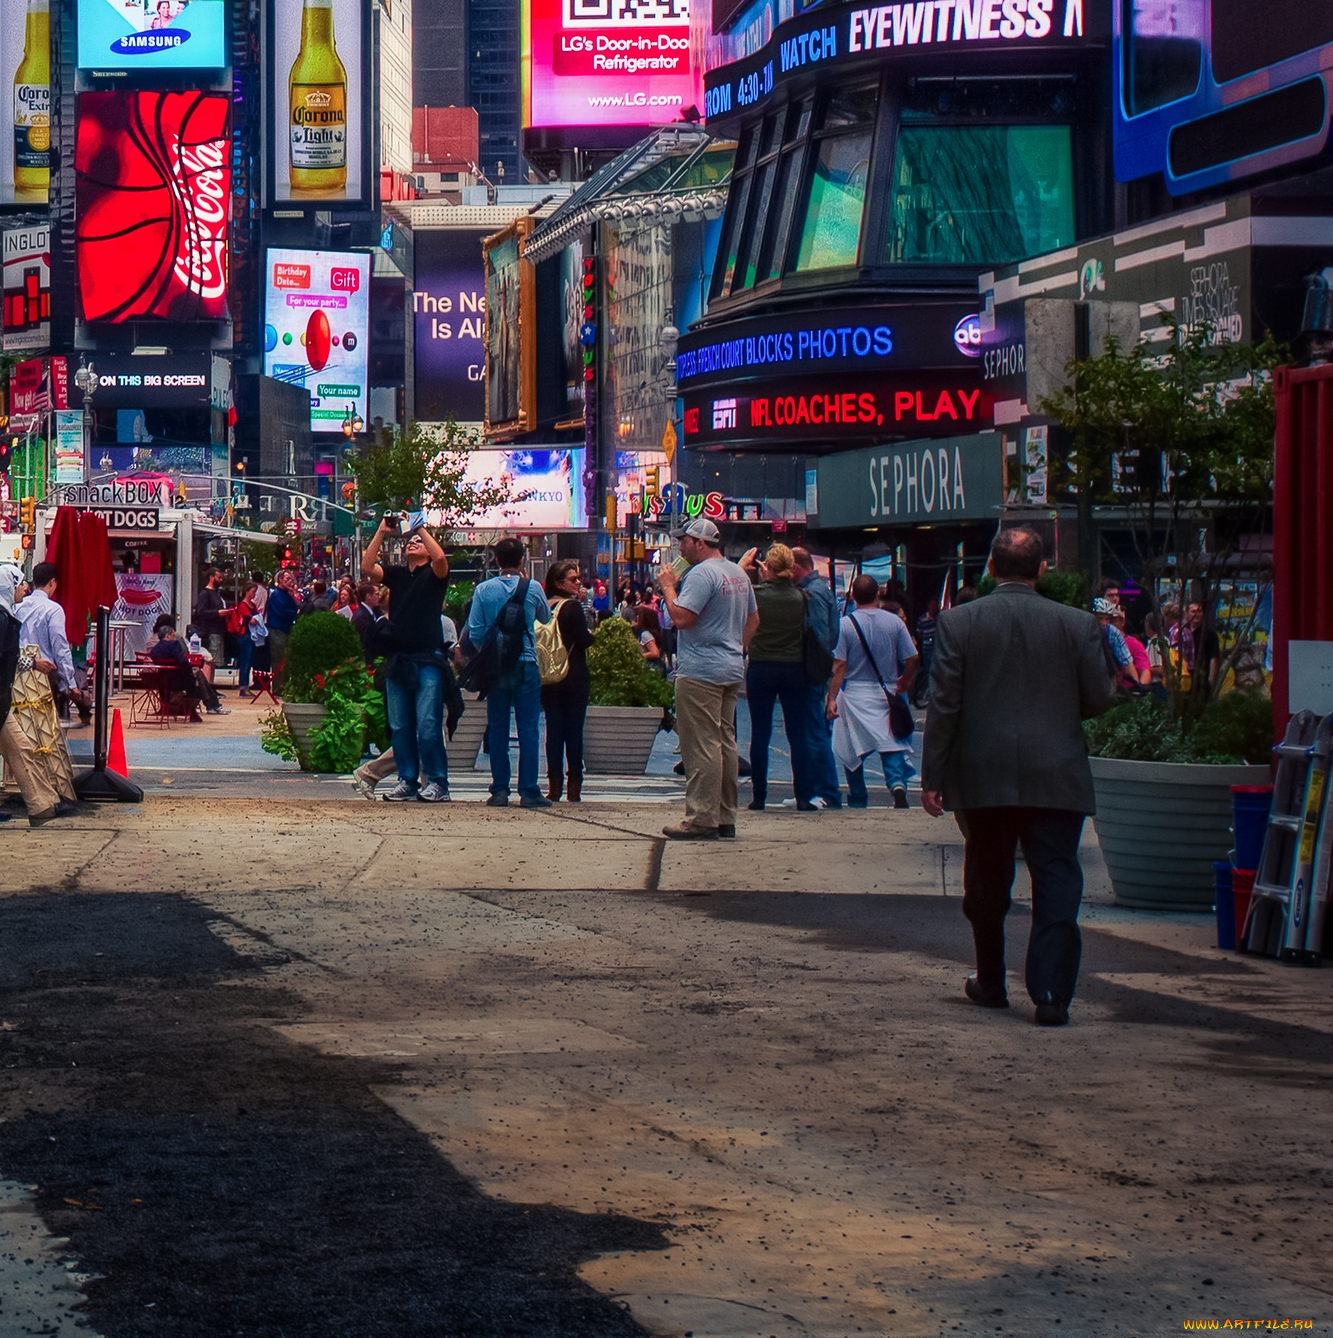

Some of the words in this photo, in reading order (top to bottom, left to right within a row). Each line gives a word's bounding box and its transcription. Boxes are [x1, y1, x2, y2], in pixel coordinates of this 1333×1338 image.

[121, 35, 182, 47] SAMSUNG
[561, 36, 594, 52] LG's
[780, 25, 836, 73] WATCH
[593, 54, 679, 72] Refrigerator
[18, 85, 50, 104] Coro
[588, 92, 683, 107] www.LG.com
[29, 100, 50, 111] Extr
[293, 105, 345, 127] Corona
[302, 127, 334, 144] Light
[277, 266, 307, 278] Birthday
[333, 272, 356, 287] Gift
[290, 296, 302, 305] For
[303, 298, 319, 307] your
[413, 292, 452, 313] The
[432, 318, 451, 339] Is
[954, 323, 981, 345] ab
[721, 339, 744, 369] COURT
[746, 332, 793, 365] BLOCKS
[798, 325, 893, 360] PHOTOS
[984, 343, 1027, 380] SEPHOR
[100, 375, 116, 386] ON
[118, 375, 141, 386] THIS
[144, 375, 161, 386] BIG
[163, 375, 205, 386] SCREEN
[320, 385, 336, 395] Your
[337, 387, 358, 396] name
[750, 397, 772, 426] NFL
[774, 392, 883, 426] COACHES,
[894, 389, 980, 423] PLAY
[869, 445, 964, 517] SEPHORA
[67, 480, 162, 504] snackBOX
[114, 511, 157, 528] DOGS
